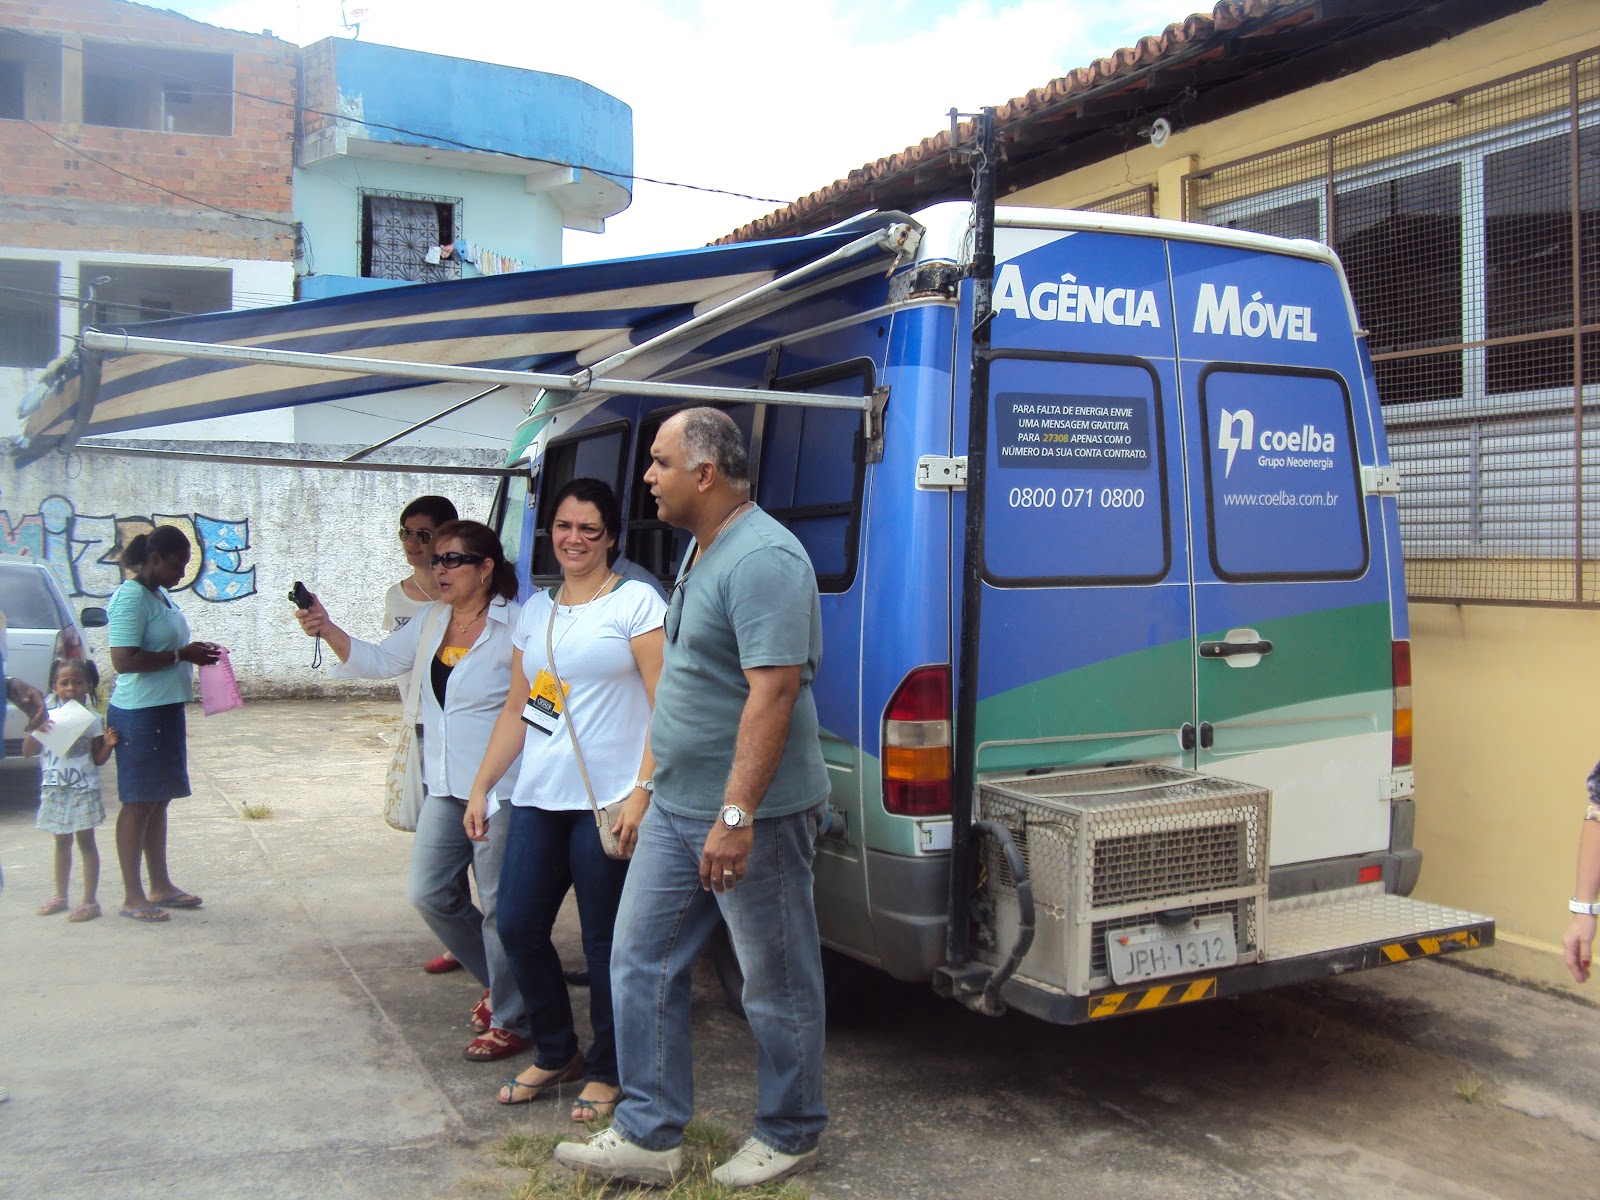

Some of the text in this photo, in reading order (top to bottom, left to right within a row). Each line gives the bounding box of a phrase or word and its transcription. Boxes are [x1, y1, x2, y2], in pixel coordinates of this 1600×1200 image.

[991, 264, 1317, 343] AGÊNCIA MÓVEL
[1012, 404, 1133, 417] PARA FALTA DE ENERGIA ENVIE
[1018, 419, 1129, 431] UMA MENSAGEM GRATUITA
[1017, 433, 1132, 444] PARA 27308 APENAS COM O
[1259, 425, 1335, 453] coelba
[1001, 445, 1148, 459] NÚMERO DA SUA CONTA CONTRATO.
[1258, 455, 1334, 470] Grupo Neoenergia
[1009, 487, 1145, 508] 0800 071 0800
[1223, 490, 1339, 506] www.coelba.com.br
